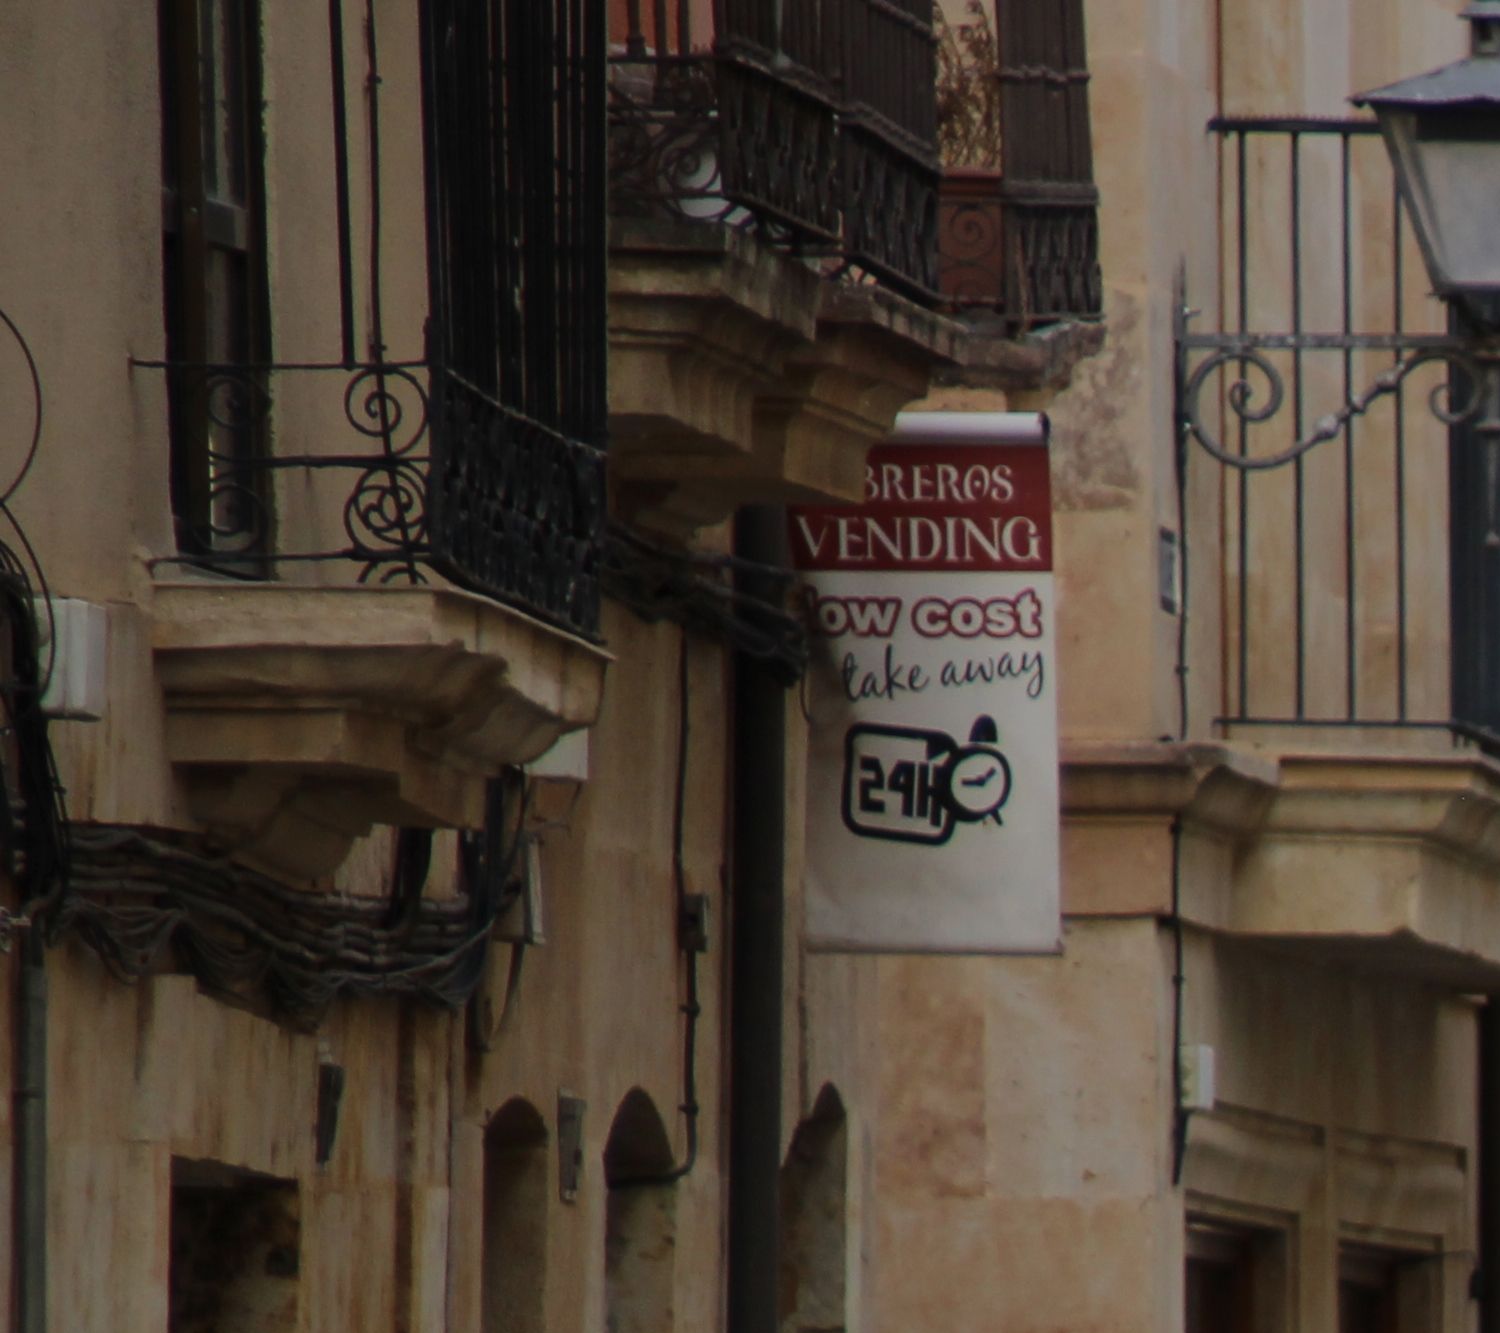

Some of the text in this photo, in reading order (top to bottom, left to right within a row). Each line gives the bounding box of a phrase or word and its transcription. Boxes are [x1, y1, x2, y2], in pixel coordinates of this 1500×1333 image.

[865, 463, 1015, 503] BREROS
[796, 515, 1042, 563] VENDING
[911, 587, 1043, 638] cost
[842, 643, 1044, 702] take away
[859, 756, 945, 828] 24H
